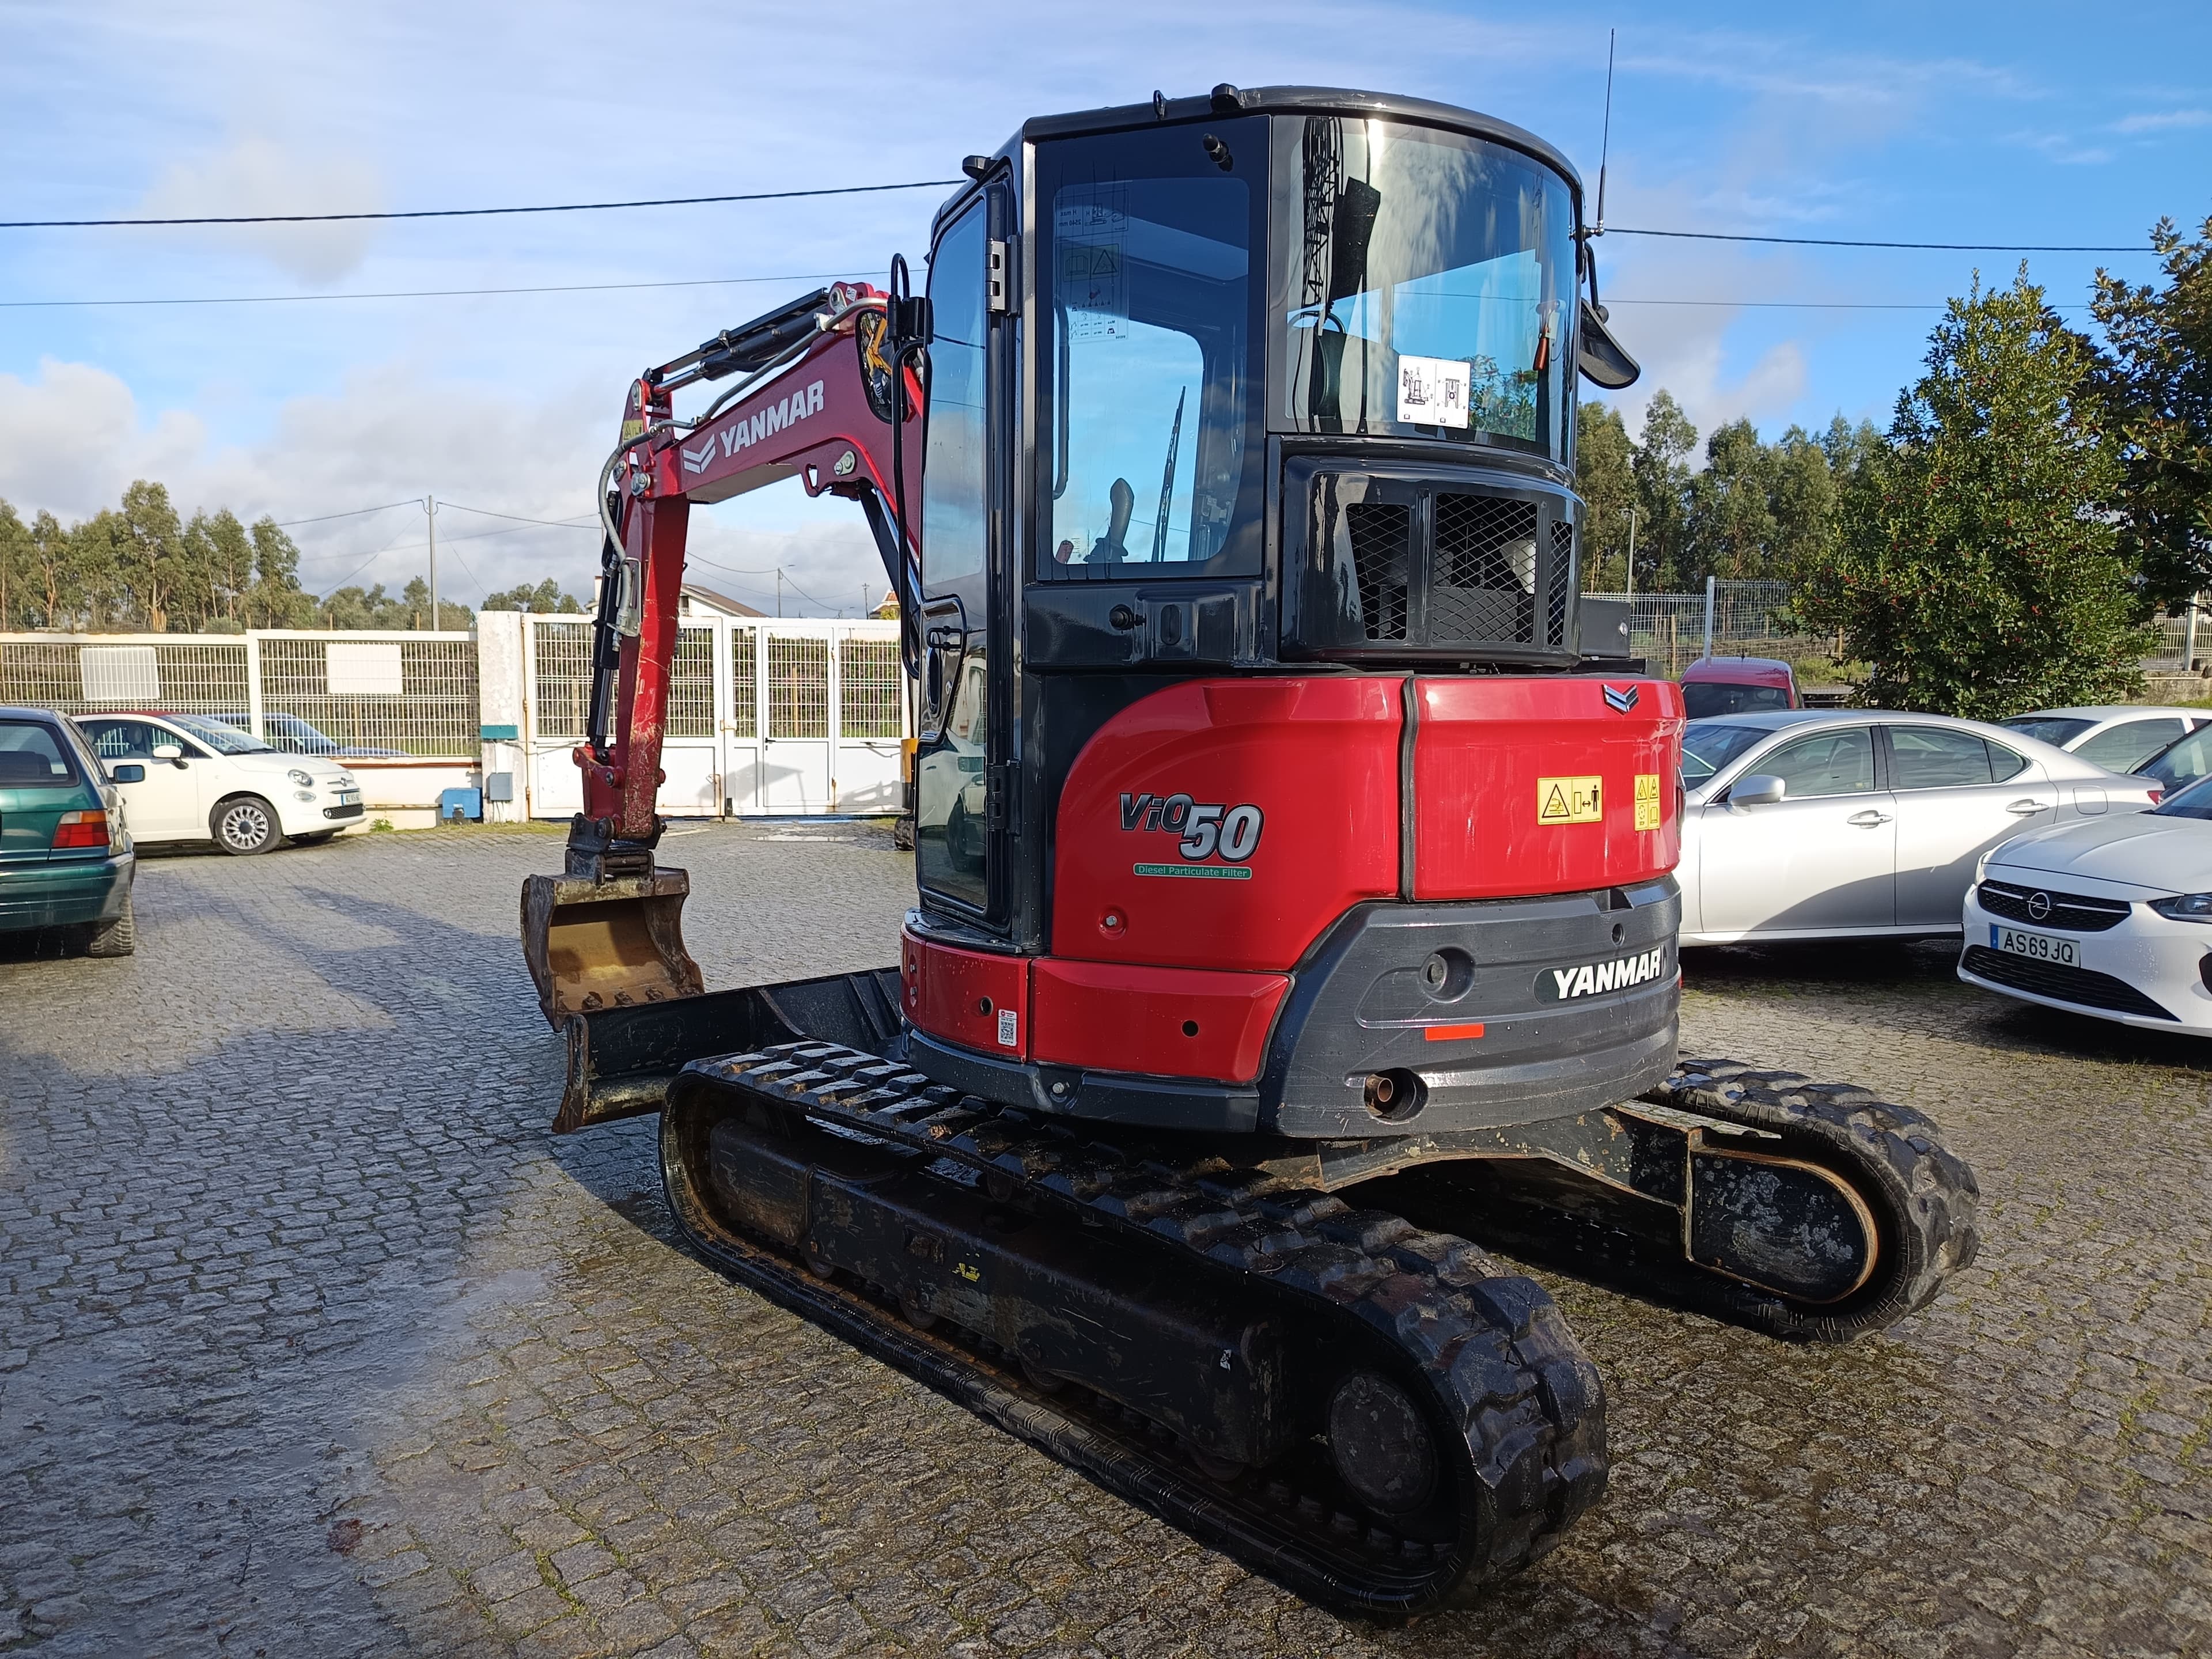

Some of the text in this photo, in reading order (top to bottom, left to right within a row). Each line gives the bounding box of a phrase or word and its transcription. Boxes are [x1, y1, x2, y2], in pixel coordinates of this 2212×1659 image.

[720, 380, 824, 457] YANMAR
[1138, 866, 1248, 877] Diesel Particulate Filter
[1554, 946, 1662, 999] YANMAR
